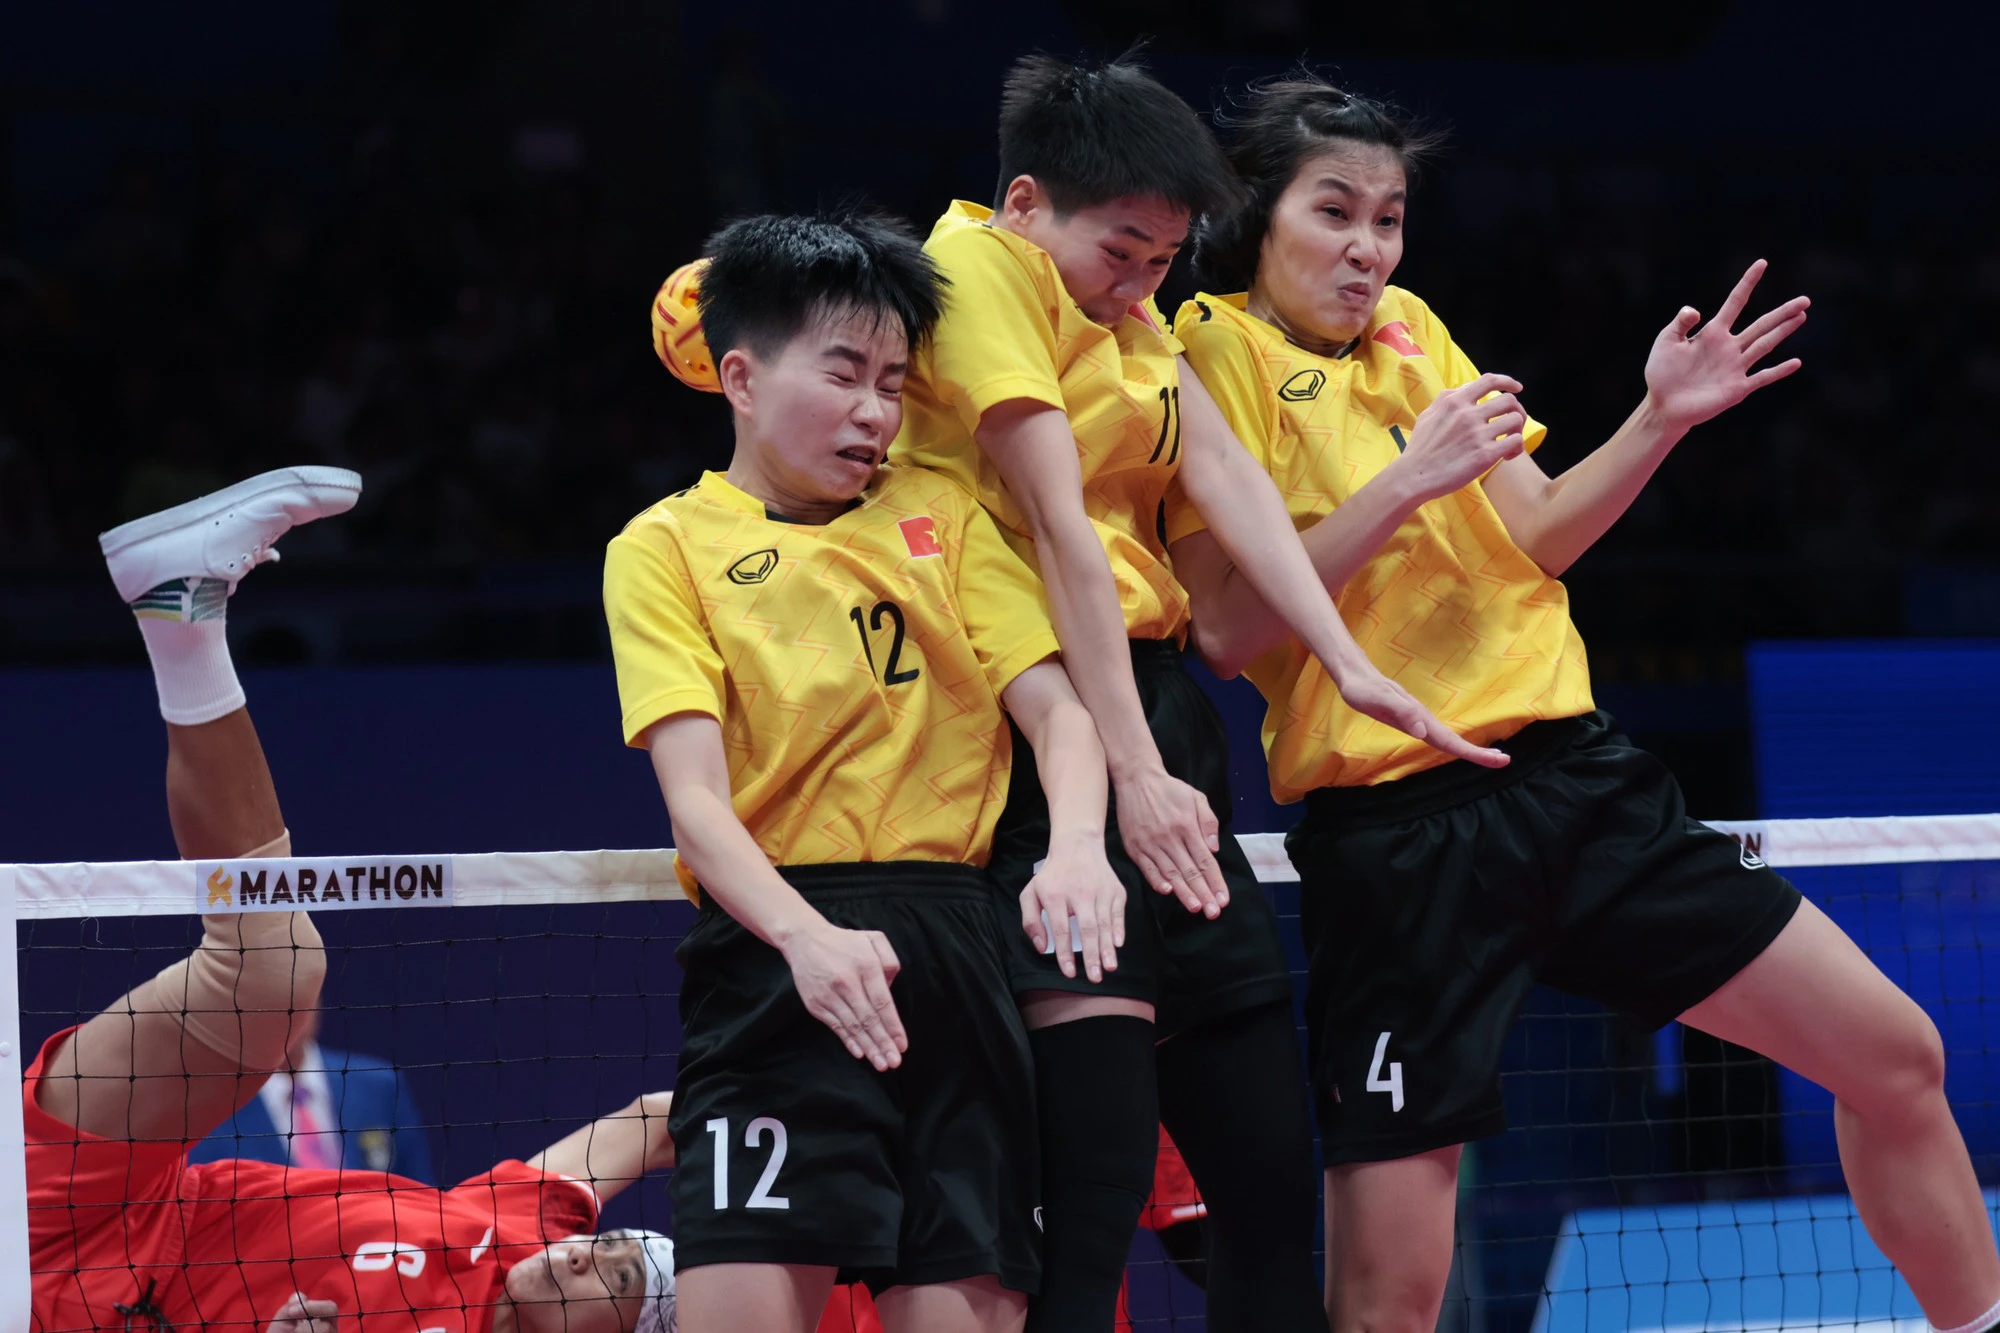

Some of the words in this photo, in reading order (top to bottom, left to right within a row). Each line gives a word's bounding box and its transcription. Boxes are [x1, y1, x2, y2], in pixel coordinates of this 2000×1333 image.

[1147, 386, 1180, 466] 11
[849, 600, 920, 686] 12
[239, 864, 443, 906] MARATHON
[1366, 1031, 1405, 1113] 4
[706, 1116, 790, 1210] 12
[352, 1241, 427, 1279] 6
